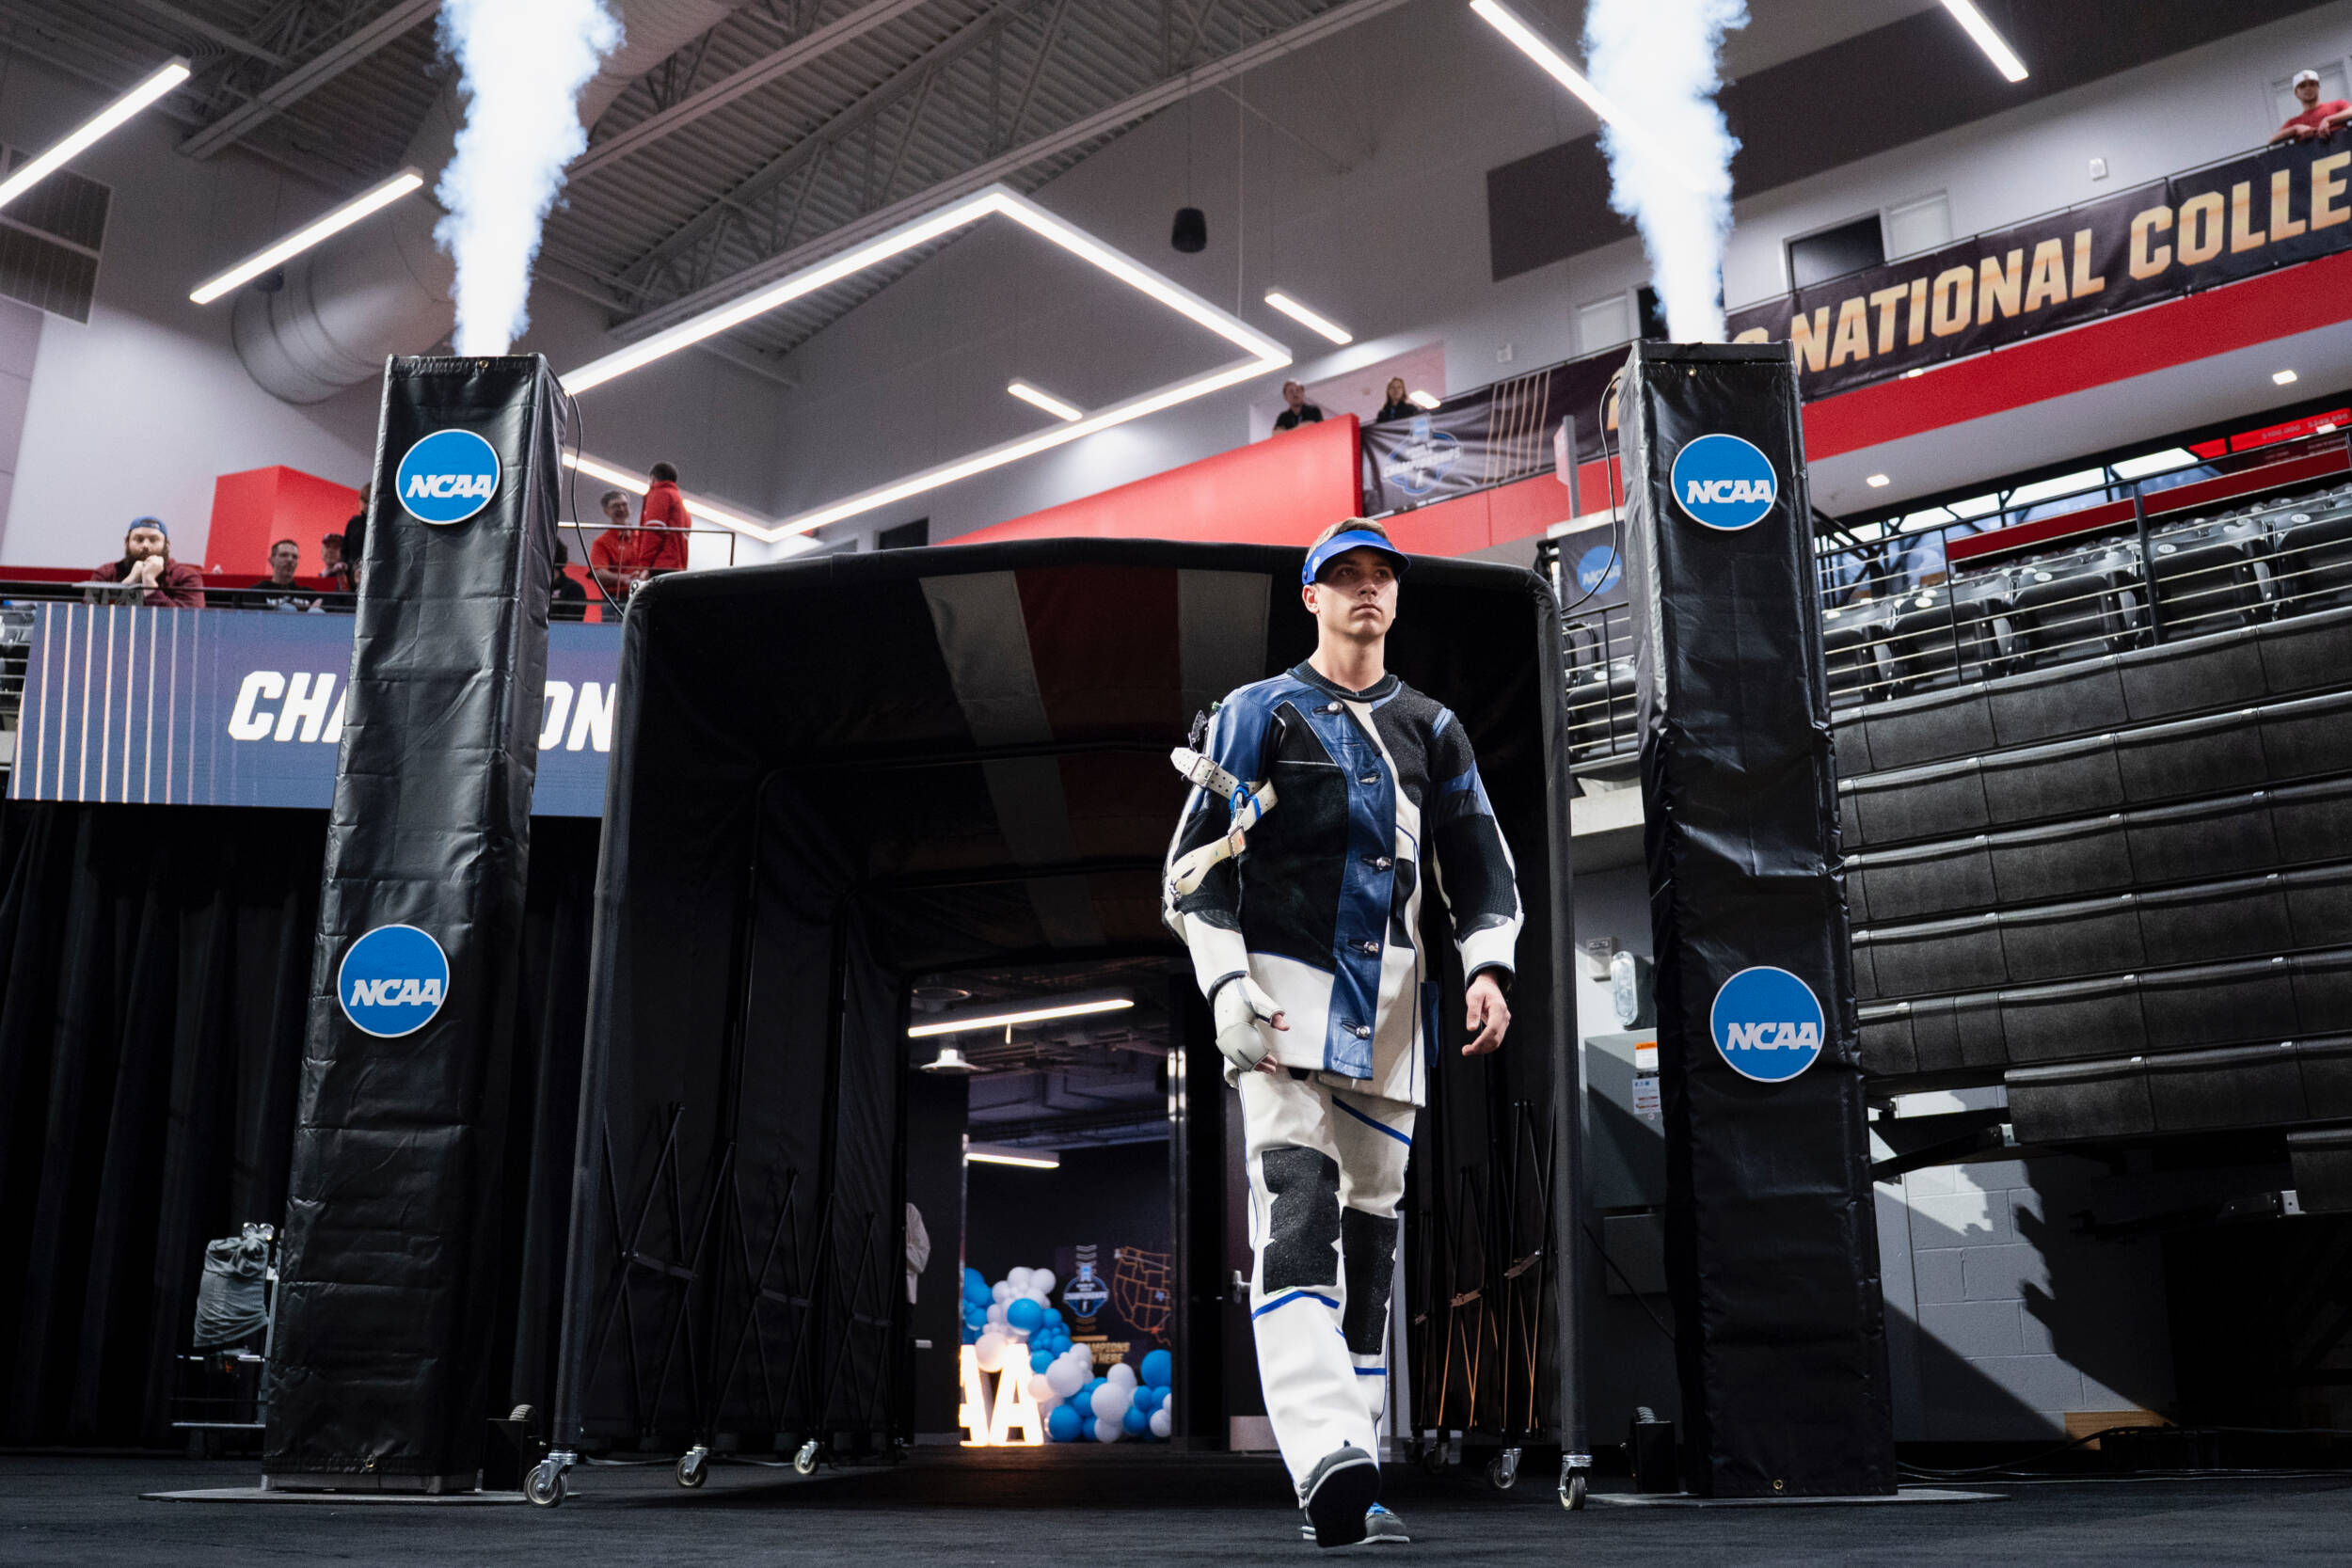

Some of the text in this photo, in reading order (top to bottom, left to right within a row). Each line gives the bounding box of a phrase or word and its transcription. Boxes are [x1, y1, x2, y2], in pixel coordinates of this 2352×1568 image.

[1790, 150, 2352, 376] NATIONAL COLLE
[405, 473, 492, 499] NCAA
[1686, 480, 1773, 504] NCAA
[349, 978, 442, 1006] NCAA
[1725, 1022, 1820, 1051] NCAA
